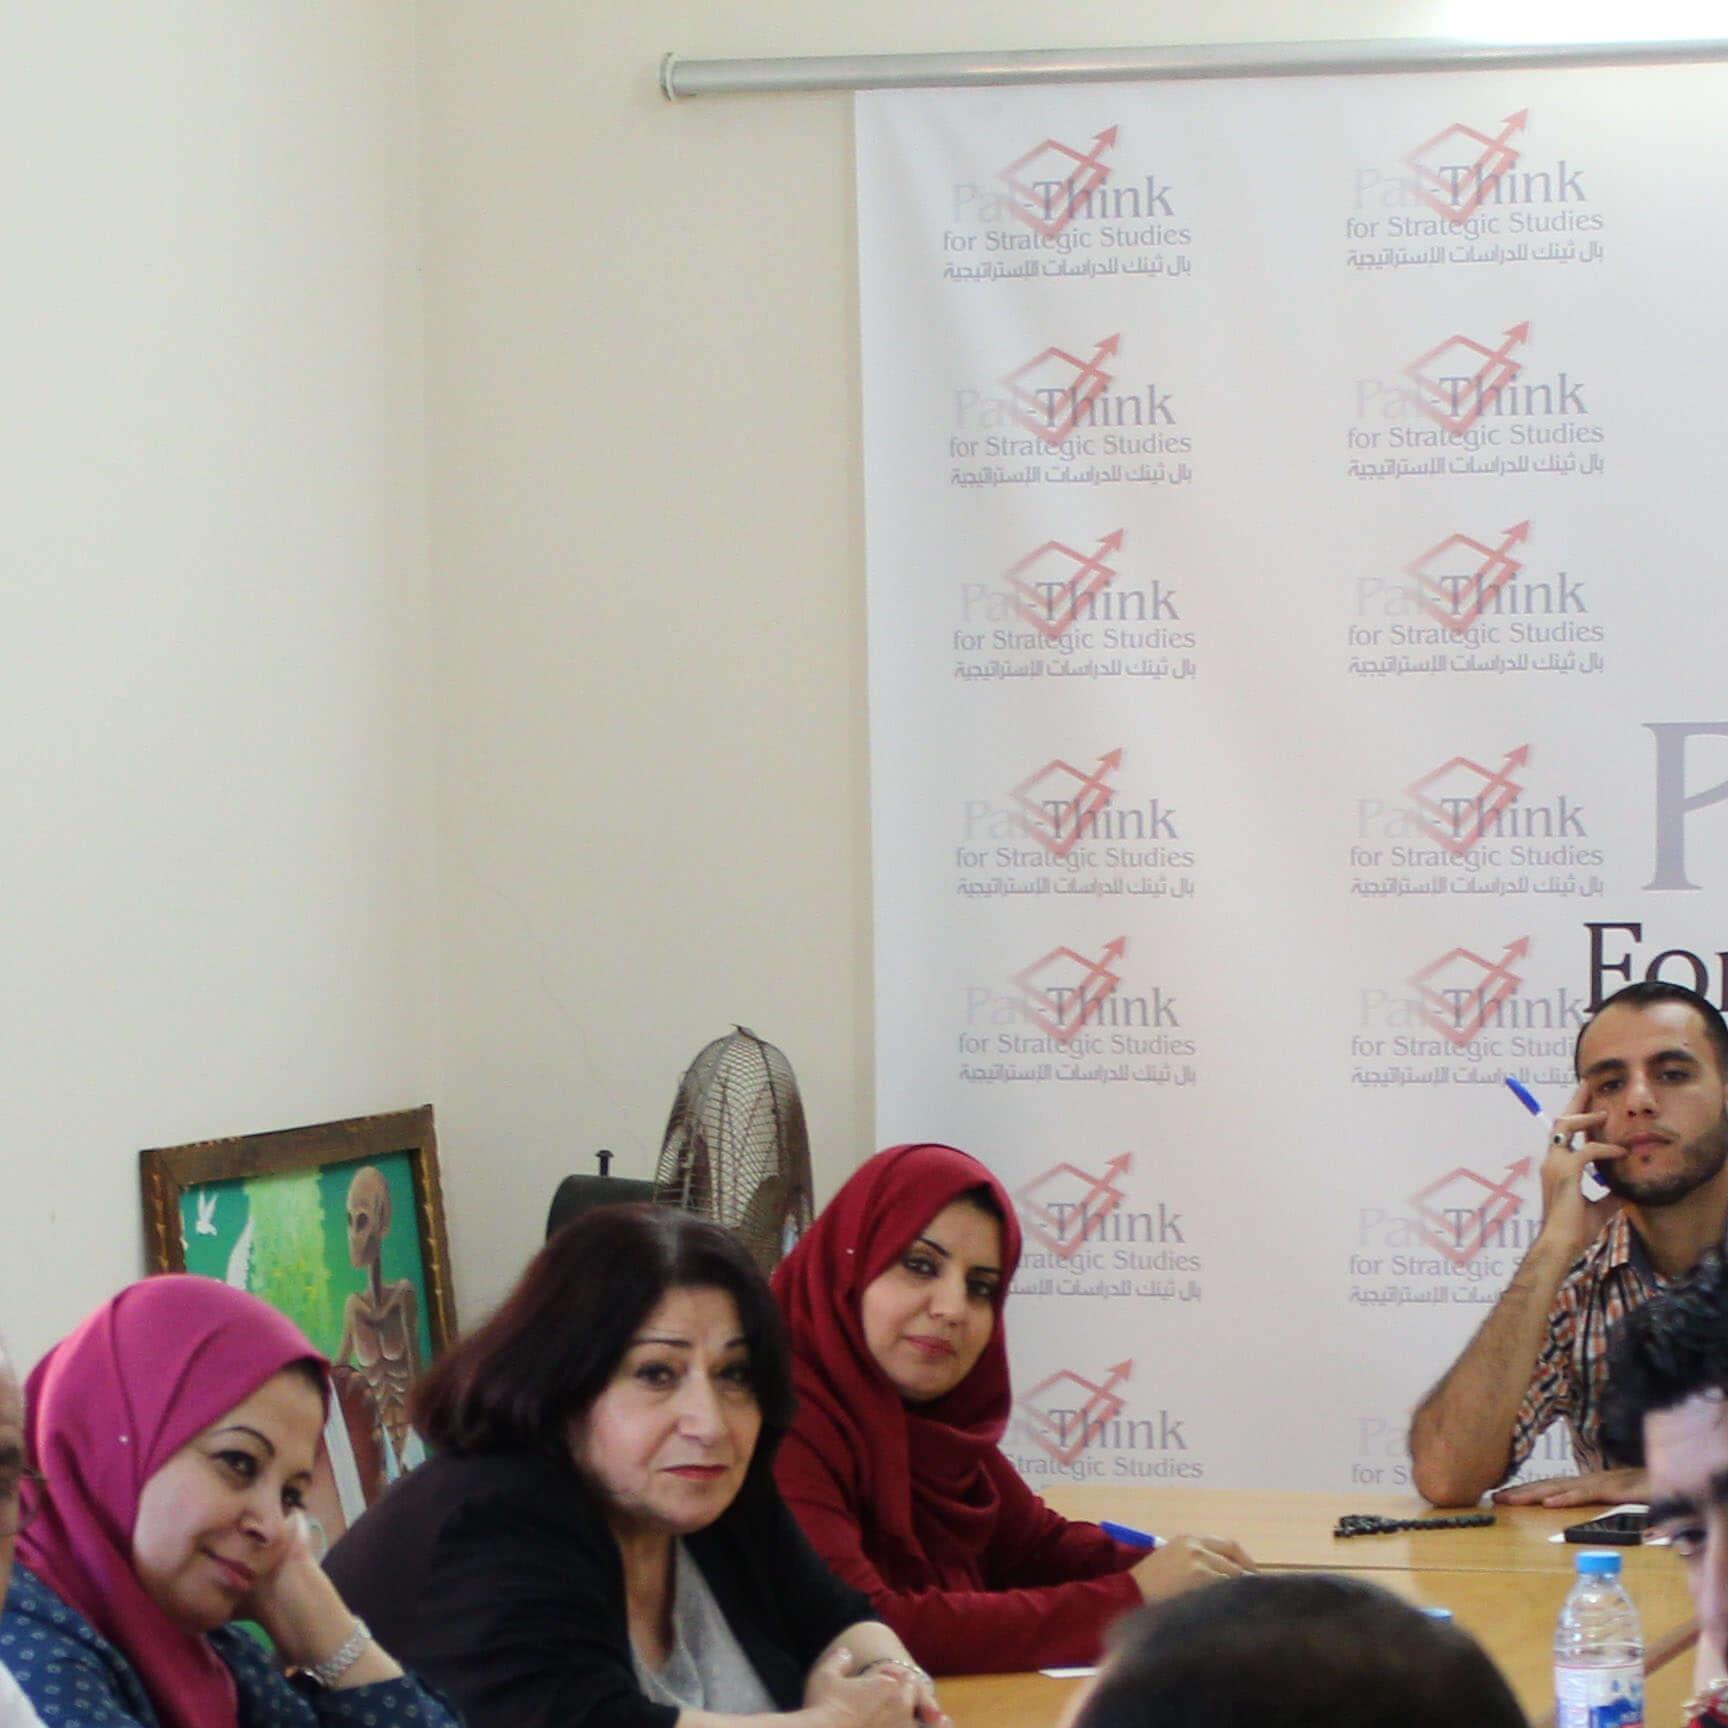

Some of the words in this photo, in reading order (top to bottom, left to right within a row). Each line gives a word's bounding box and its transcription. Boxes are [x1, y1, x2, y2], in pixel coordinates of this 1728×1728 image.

[1346, 217, 1380, 238] for
[1388, 215, 1501, 241] Strategic
[1509, 210, 1604, 233] Studies
[944, 231, 977, 252] for
[984, 230, 1092, 254] Strategic
[1100, 225, 1191, 247] Studies
[948, 437, 980, 457] for
[987, 437, 1095, 460] Strategic
[1102, 434, 1192, 454] Studies
[1347, 427, 1381, 448] for
[1389, 427, 1502, 451] Strategic
[1510, 423, 1604, 445] Studies
[951, 630, 984, 650] for
[990, 631, 1097, 653] Strategic
[1105, 629, 1194, 649] Studies
[1349, 625, 1382, 645] for
[1390, 625, 1502, 648] Strategic
[1510, 622, 1604, 643] Studies
[957, 847, 989, 867] for
[995, 849, 1099, 872] Strategic
[1106, 847, 1193, 868] Studies
[1350, 846, 1383, 867] for
[1391, 848, 1502, 871] Strategic
[1510, 846, 1604, 866] Studies
[960, 1033, 991, 1053] for
[998, 1035, 1102, 1059] Strategic
[1110, 1035, 1197, 1056] Studies
[1351, 1035, 1384, 1056] for
[1113, 1250, 1202, 1272] Studies
[1352, 1253, 1385, 1274] for
[1114, 1455, 1204, 1478] Studies
[1354, 1462, 1386, 1483] for
